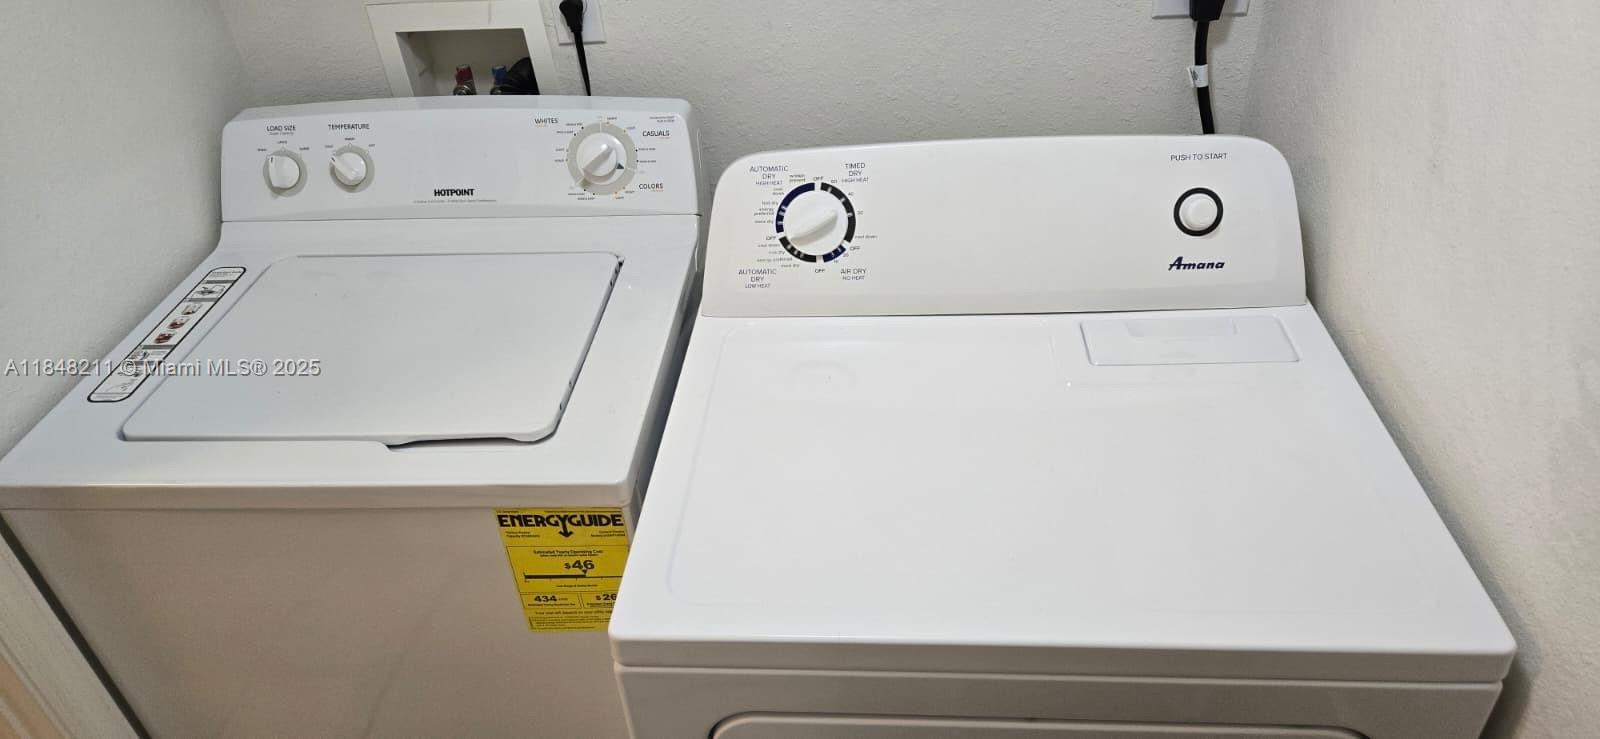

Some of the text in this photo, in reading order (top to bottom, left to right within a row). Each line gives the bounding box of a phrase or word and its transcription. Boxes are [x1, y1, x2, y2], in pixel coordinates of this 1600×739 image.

[434, 188, 475, 197] HOTPOINT
[1168, 255, 1226, 272] Amana
[496, 514, 625, 529] ENERGYGUIDE
